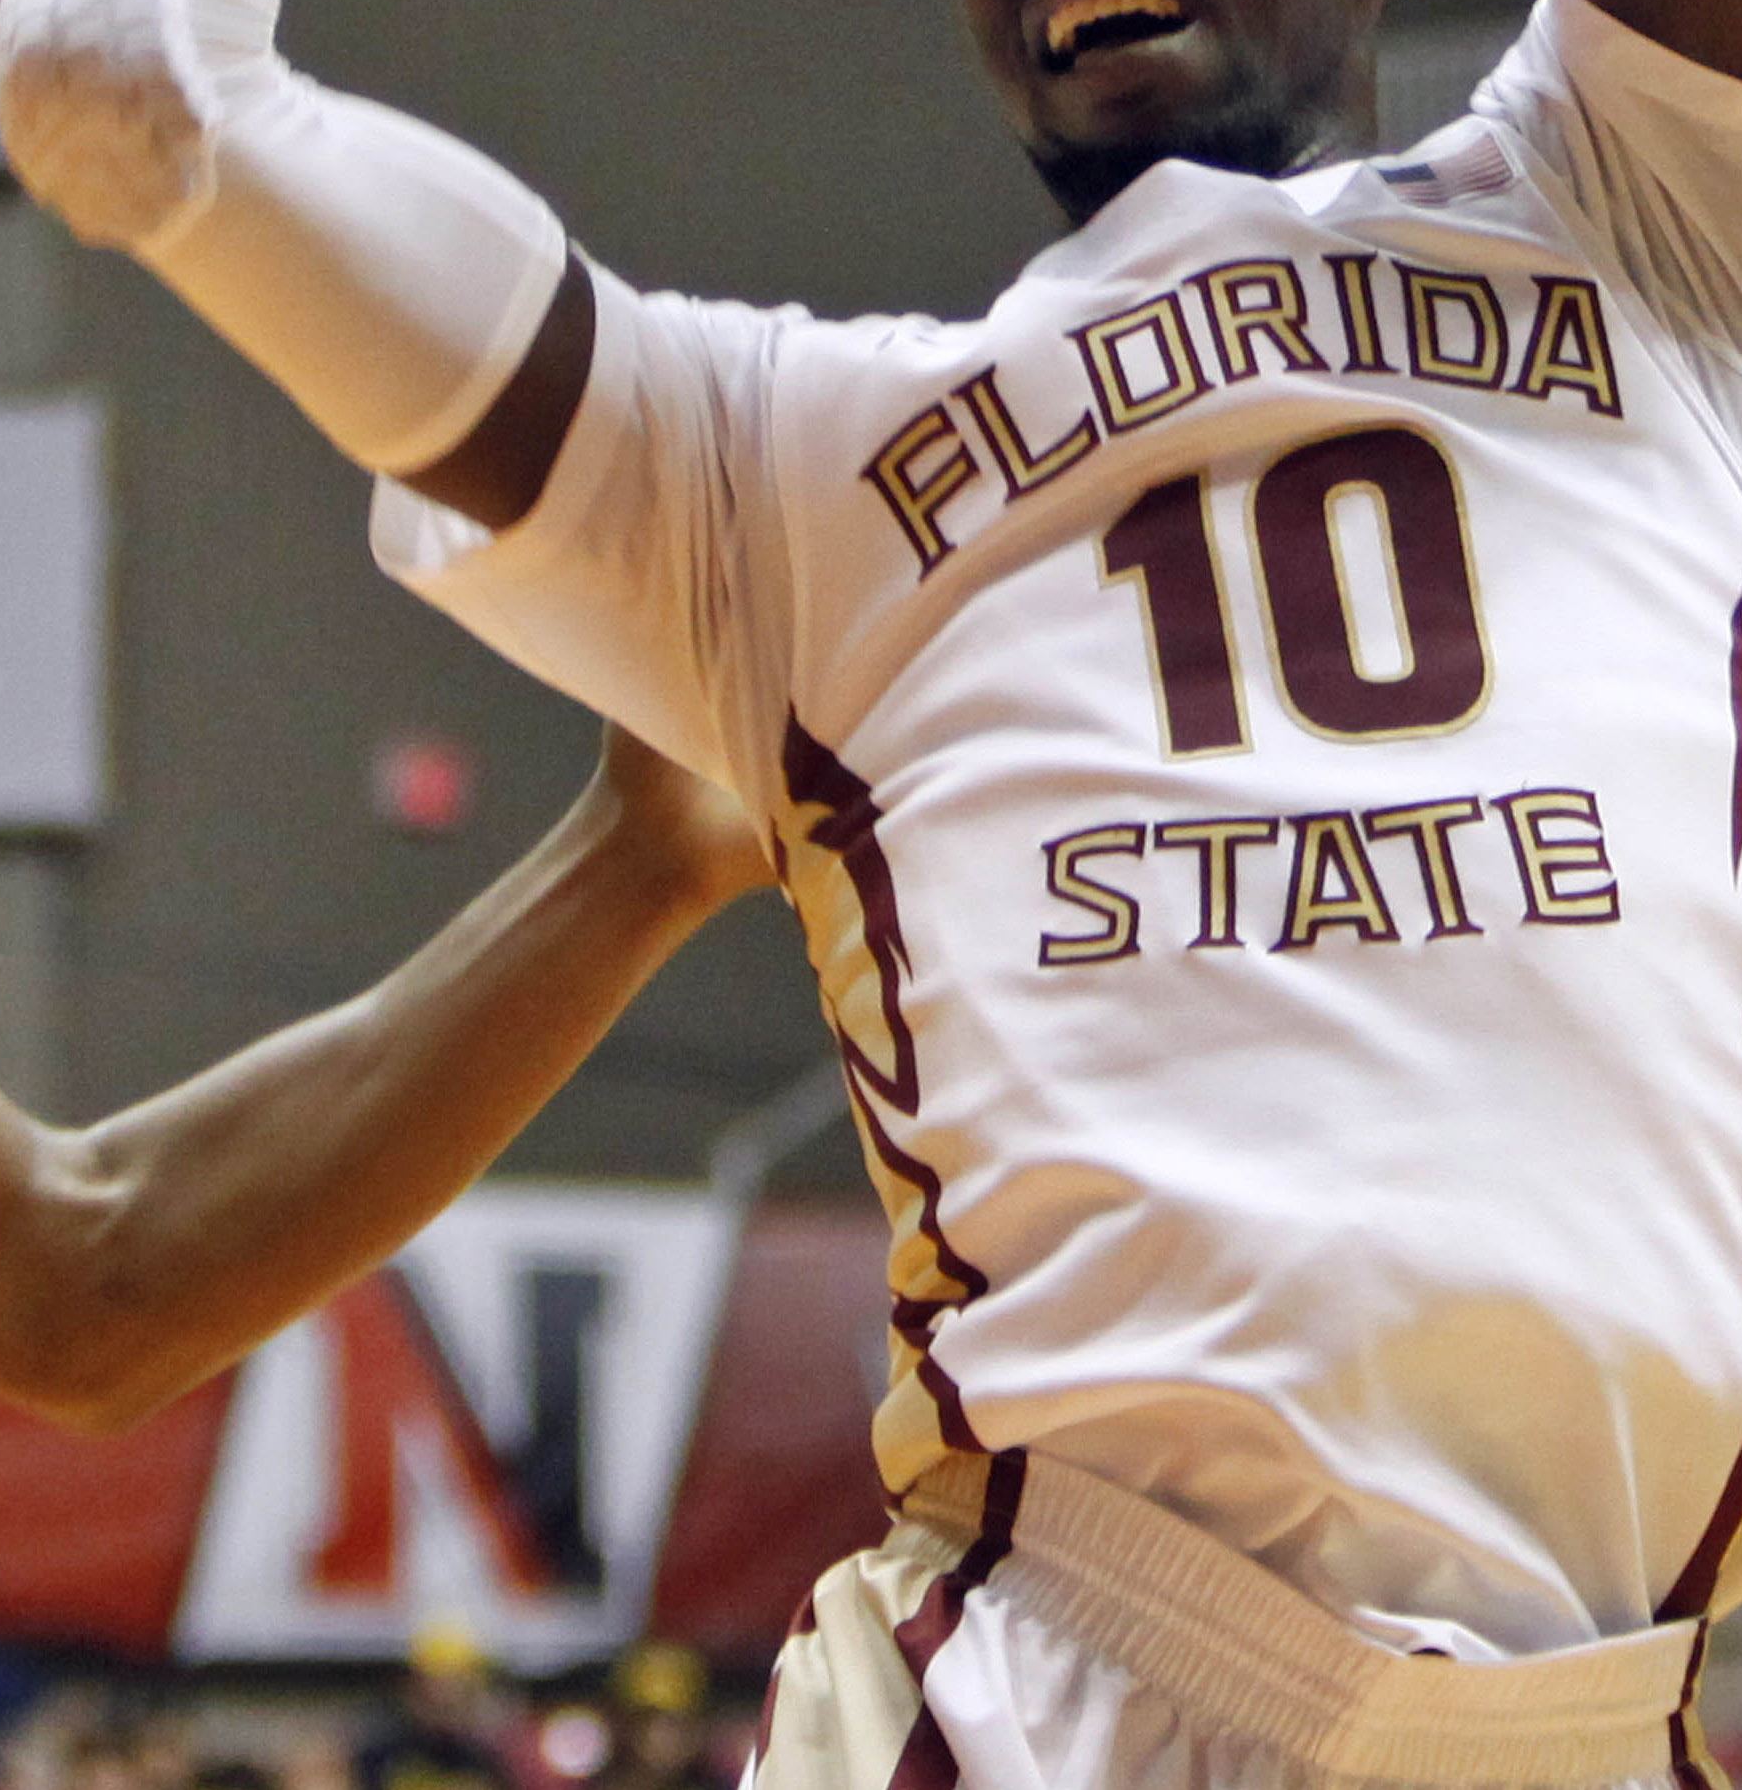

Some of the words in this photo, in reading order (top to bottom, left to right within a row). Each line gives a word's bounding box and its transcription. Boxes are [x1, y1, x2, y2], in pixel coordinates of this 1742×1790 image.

[861, 252, 1625, 582] FLORIDA
[1097, 422, 1495, 762] 10
[1037, 788, 1623, 968] STATE
